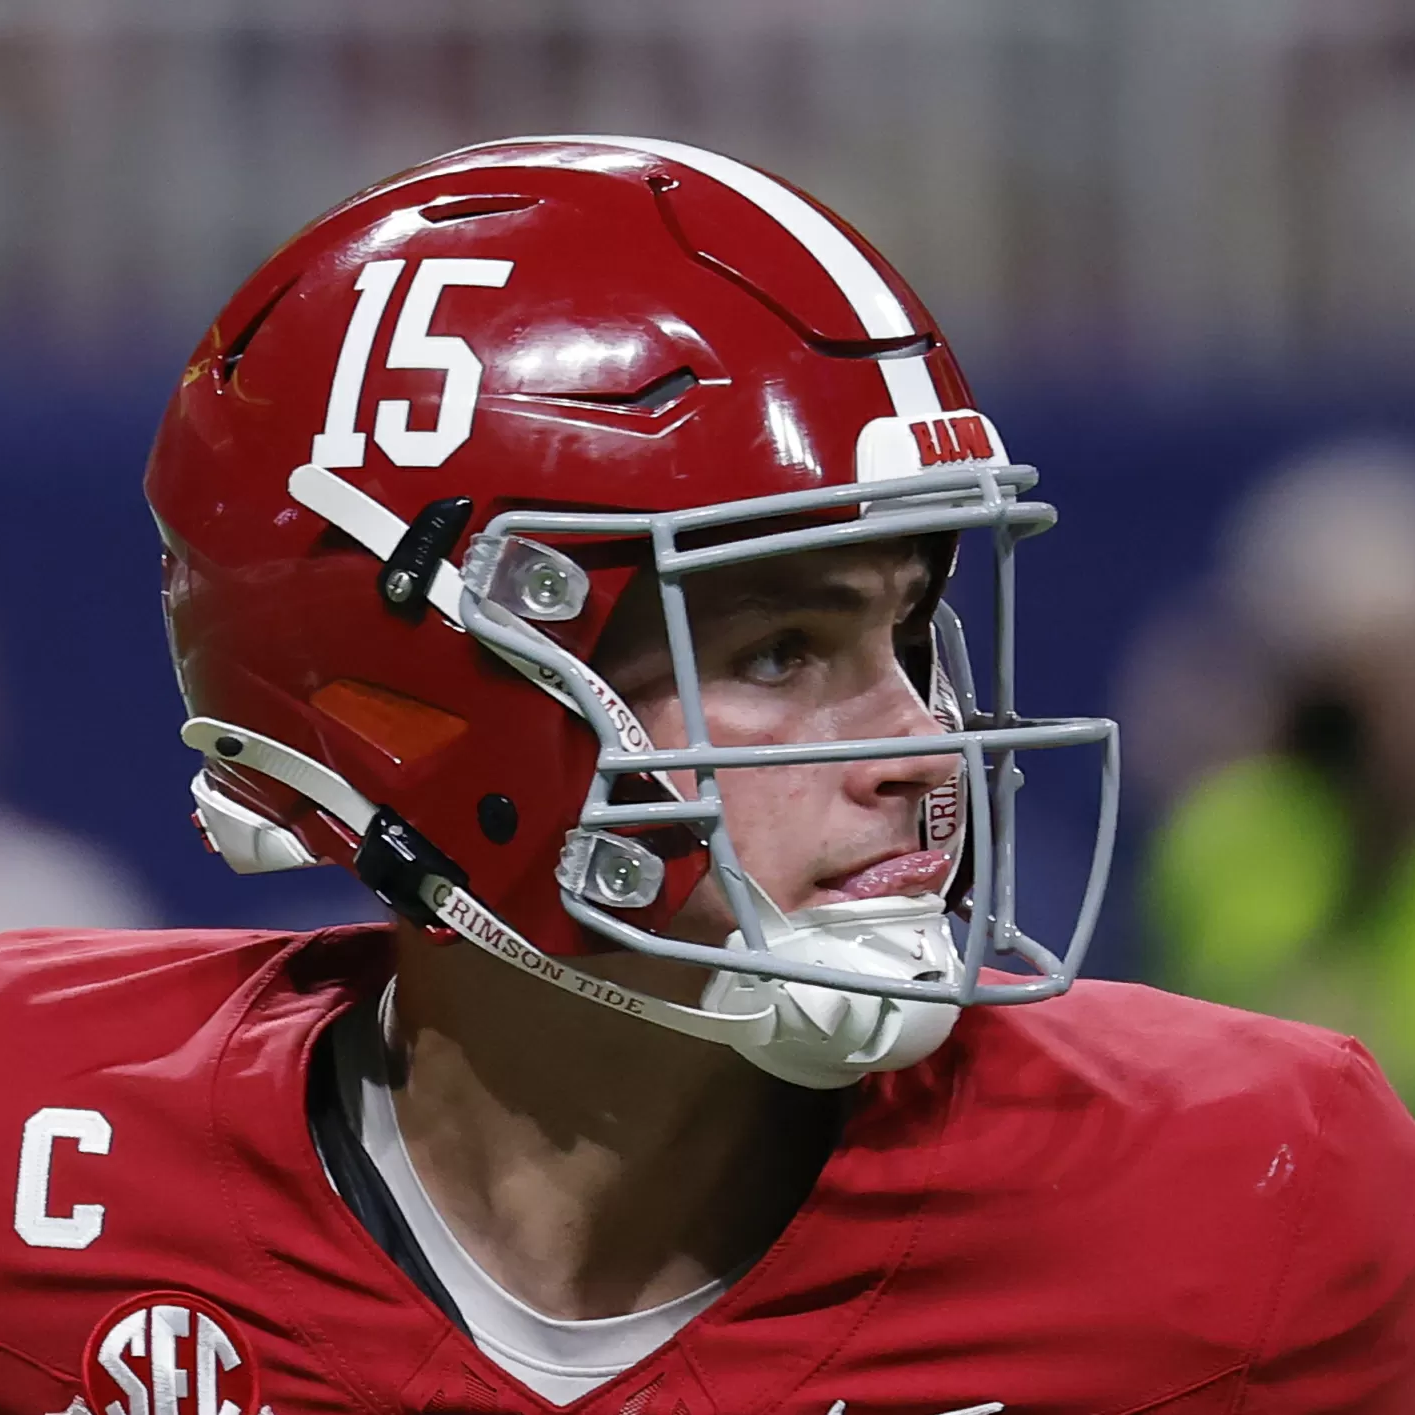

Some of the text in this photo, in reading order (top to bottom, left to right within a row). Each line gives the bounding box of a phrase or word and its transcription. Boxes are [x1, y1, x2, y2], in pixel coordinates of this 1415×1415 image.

[312, 258, 515, 468] 15
[432, 883, 644, 1015] CRIMSON TIDE
[13, 1107, 113, 1250] C
